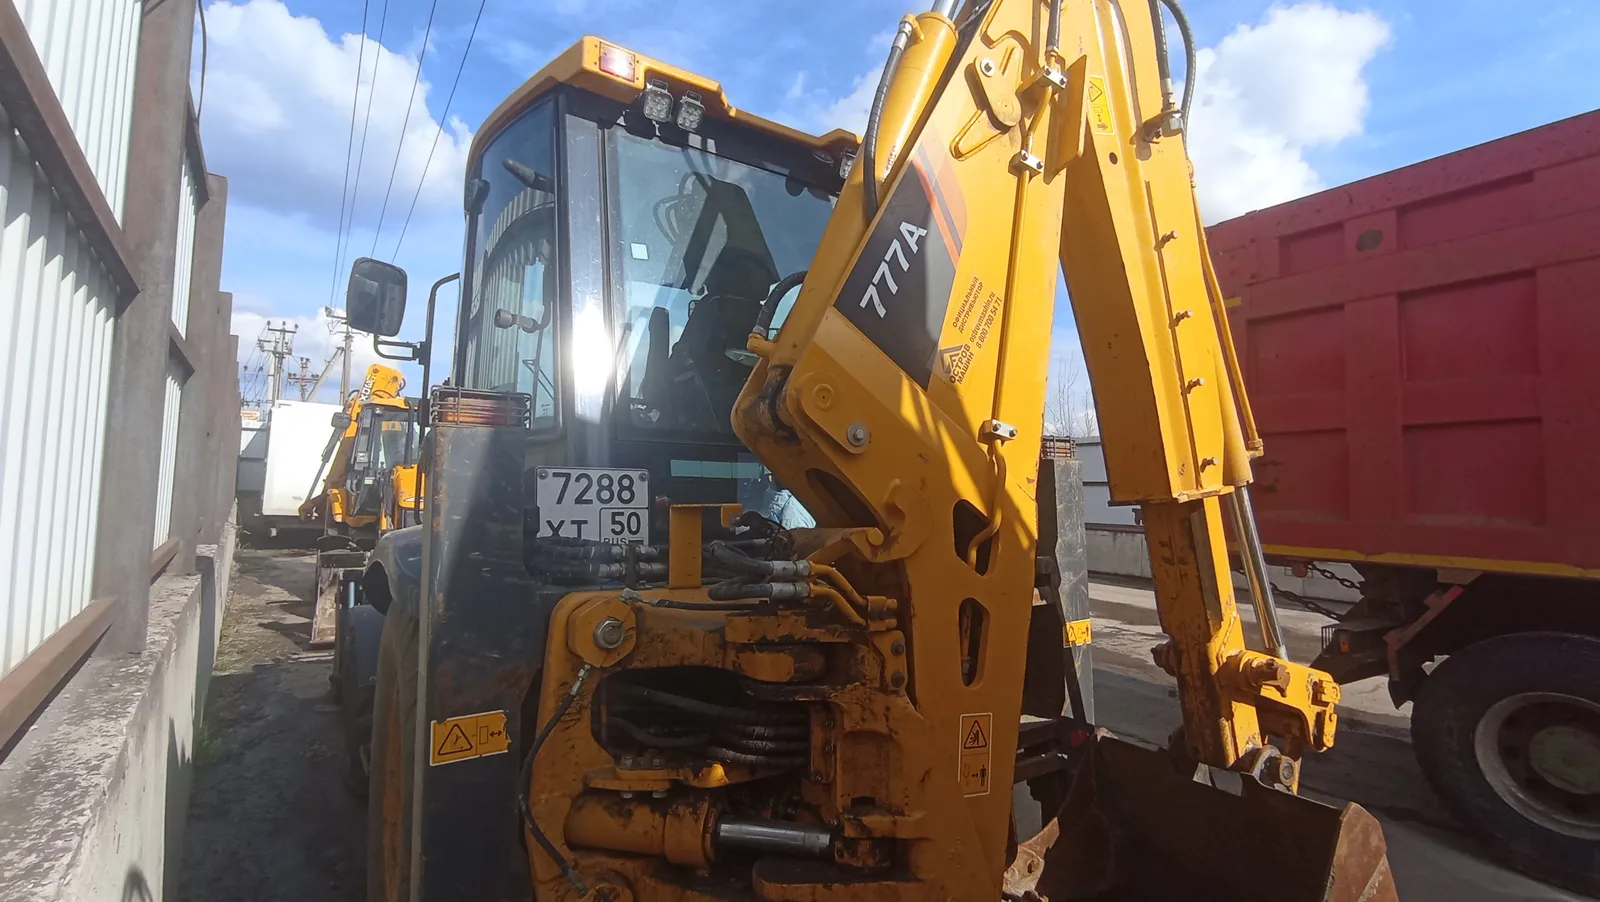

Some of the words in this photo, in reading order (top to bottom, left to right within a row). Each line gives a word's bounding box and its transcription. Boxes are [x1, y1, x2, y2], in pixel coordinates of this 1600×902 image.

[859, 221, 928, 319] 777A
[952, 276, 980, 328] ОФИЦИАЛЬНЫЙ
[957, 281, 985, 335] ДИСТРИБЬЮТОР
[969, 291, 996, 343] ostrovmashin.ru
[984, 314, 995, 329] 700
[949, 343, 972, 384] ОСТРОВ
[956, 351, 975, 385] МАШИН
[552, 472, 636, 505] 7288
[610, 511, 642, 536] 50
